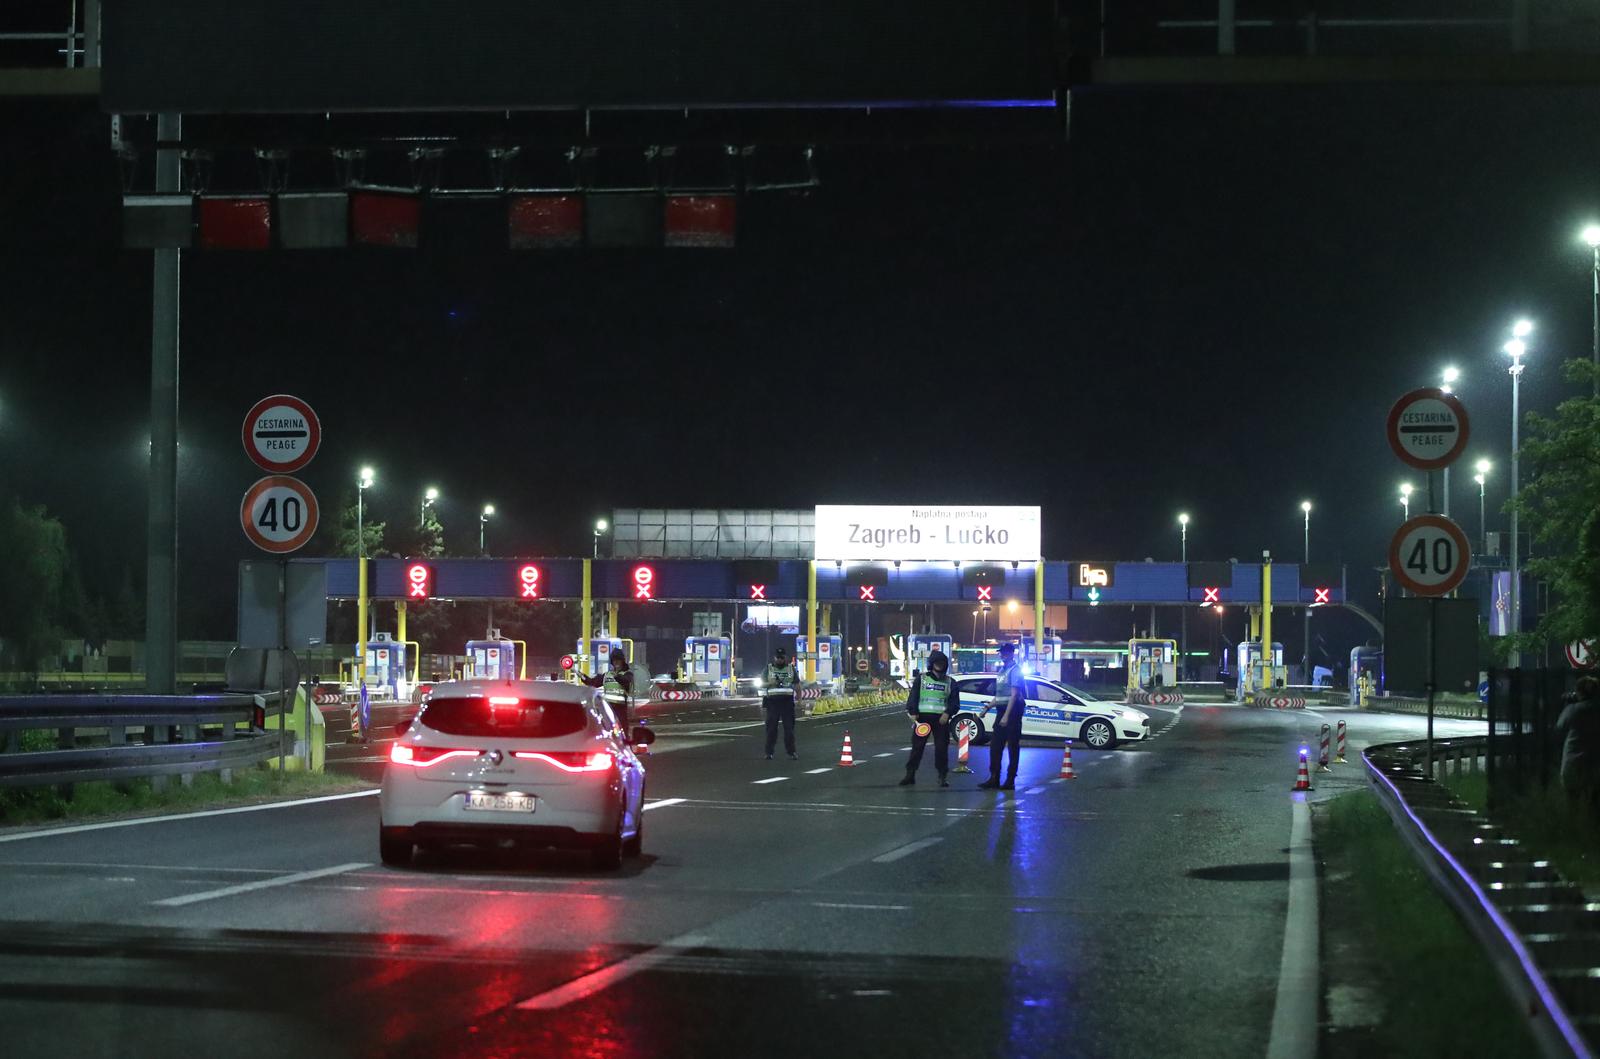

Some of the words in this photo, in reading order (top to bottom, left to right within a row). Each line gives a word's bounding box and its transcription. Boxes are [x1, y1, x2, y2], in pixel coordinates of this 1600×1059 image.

[1403, 412, 1453, 423] CESTARINA
[258, 419, 304, 429] CESTARINA
[266, 440, 296, 449] PEAGE
[1411, 435, 1444, 445] PEAGE
[258, 497, 301, 532] 40
[912, 509, 951, 519] Naplatna
[848, 524, 921, 548] Zagreb
[945, 524, 1009, 545] Lučko
[1406, 537, 1452, 575] 40
[1025, 709, 1059, 718] POLICIJA
